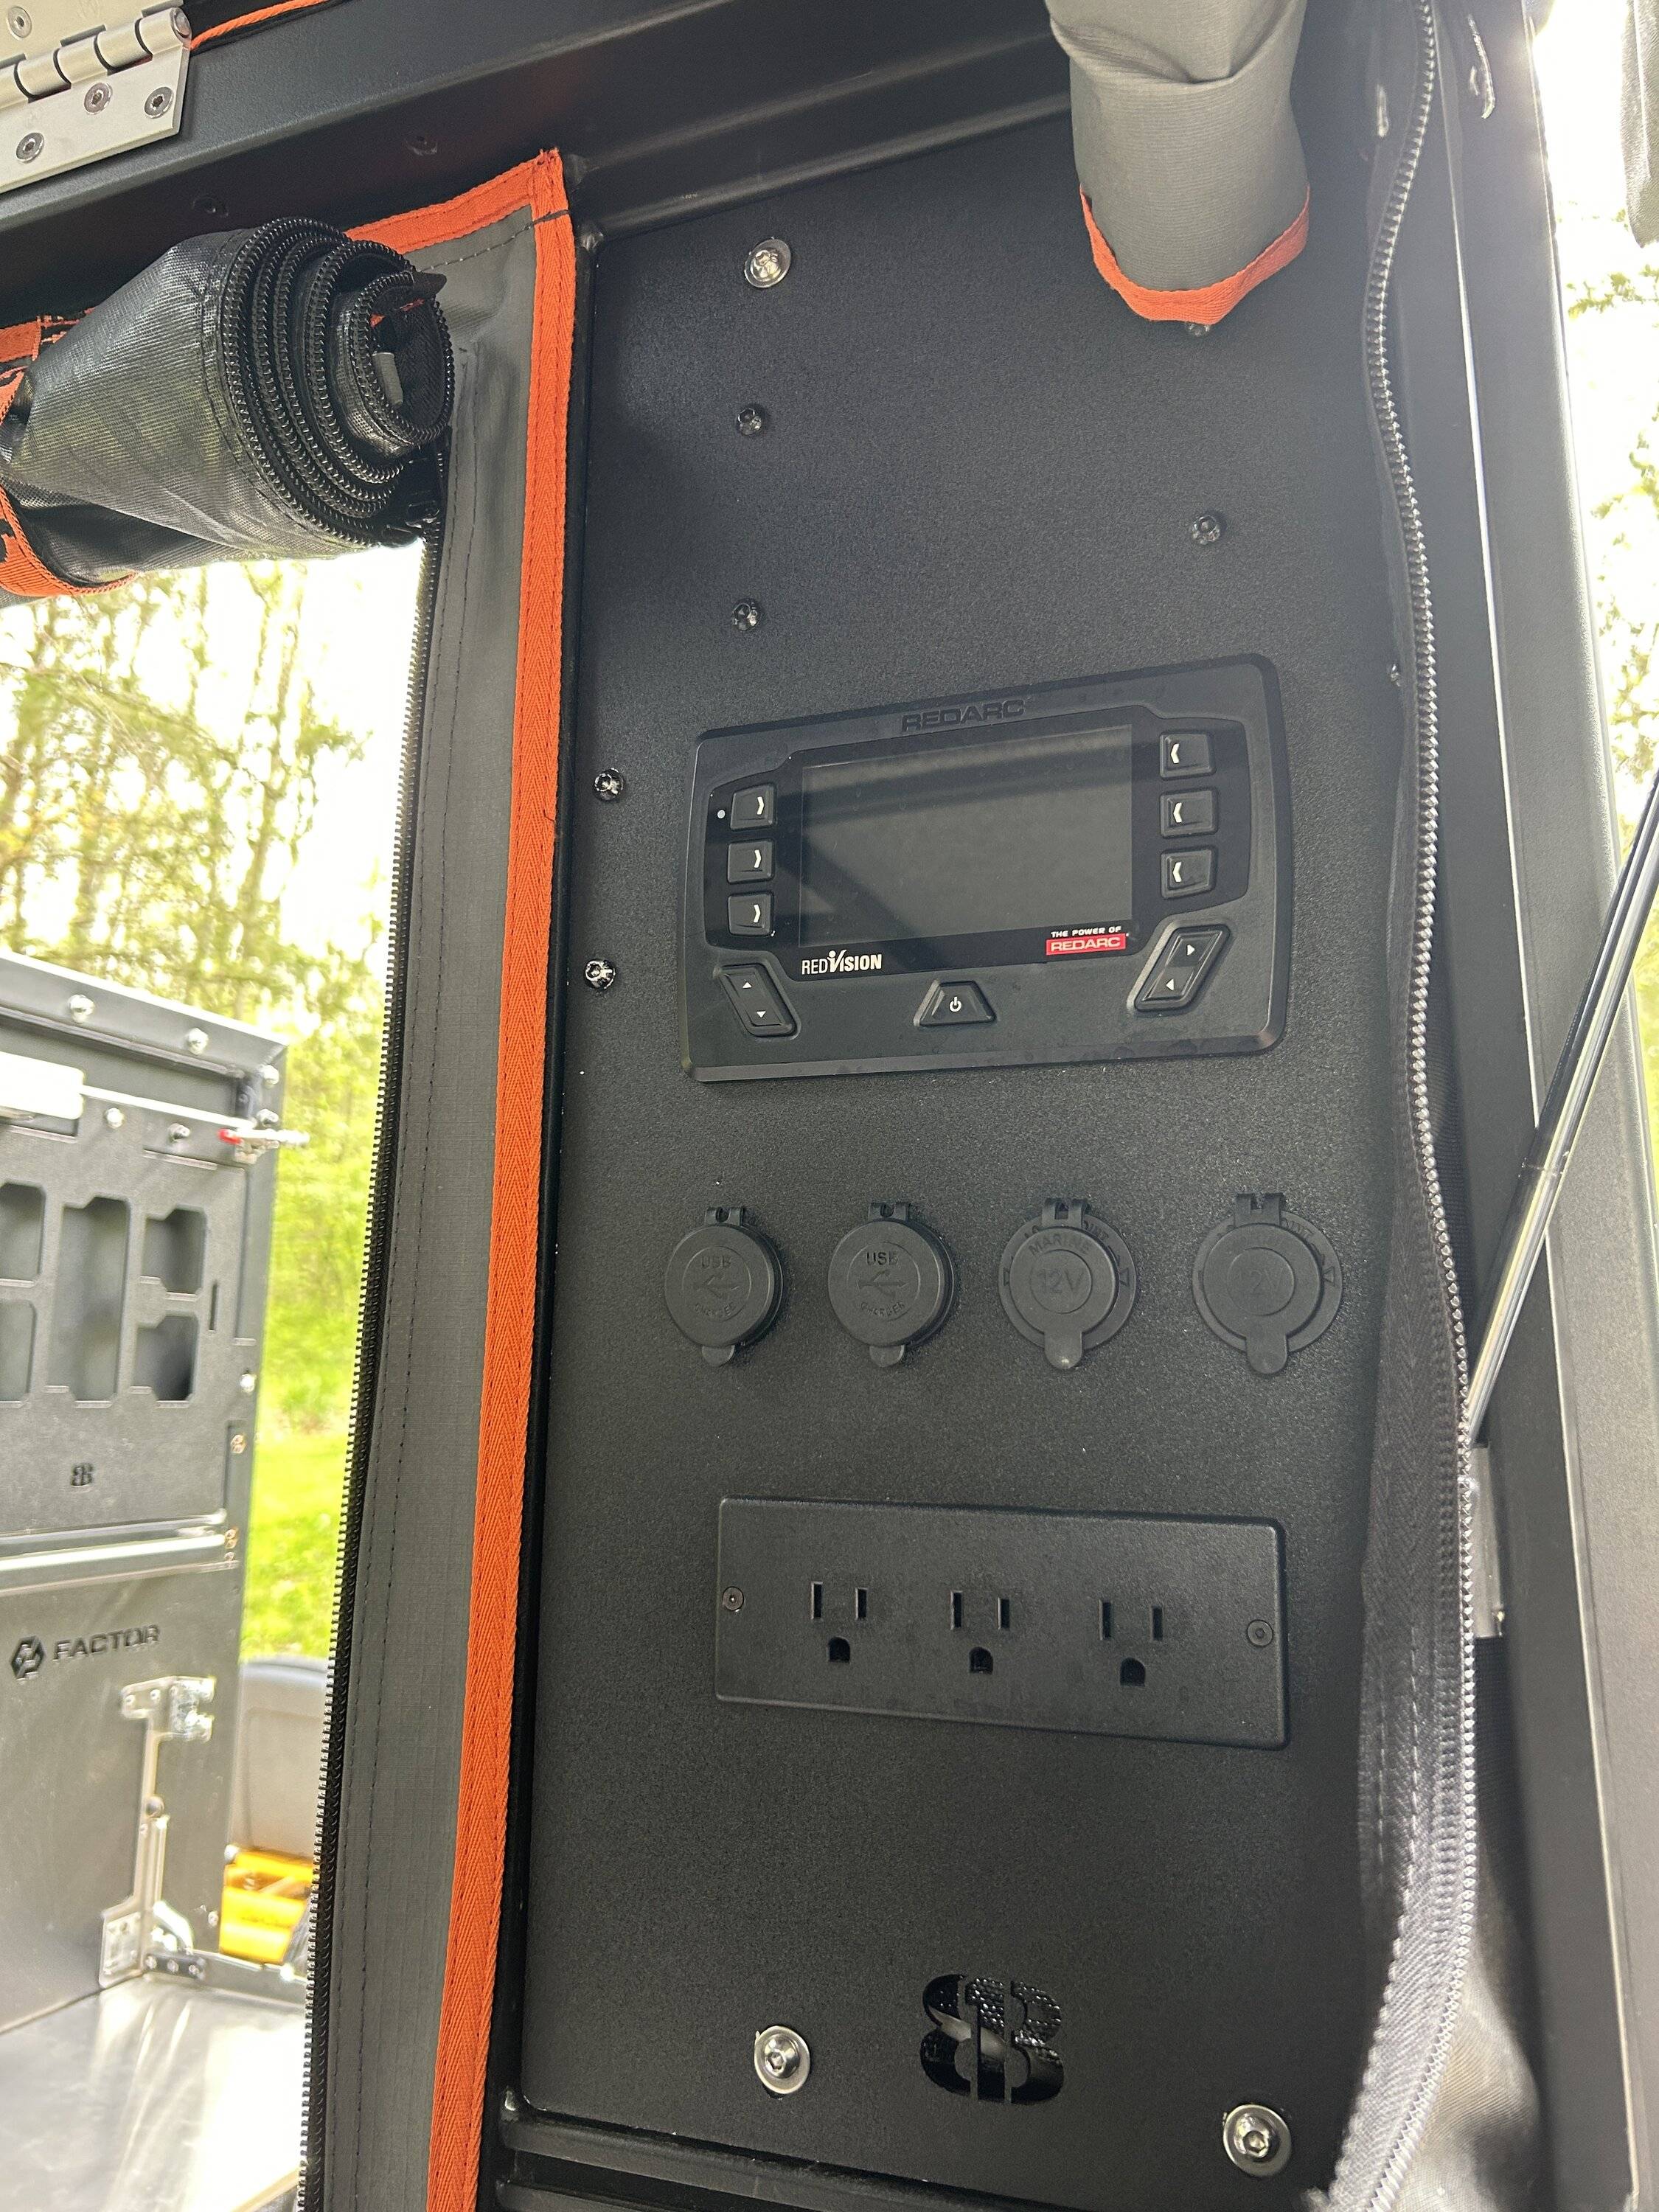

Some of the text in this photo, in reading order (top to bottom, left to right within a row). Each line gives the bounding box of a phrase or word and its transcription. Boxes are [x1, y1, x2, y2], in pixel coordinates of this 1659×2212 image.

[901, 700, 1026, 732] REDARC
[1072, 927, 1105, 936] POWER
[1108, 925, 1121, 933] OF
[1051, 937, 1121, 952] REDARC
[701, 1255, 731, 1269] USB
[866, 1251, 899, 1266] USB
[1037, 1268, 1086, 1295] 12V
[52, 1624, 160, 1660] FACTOR
